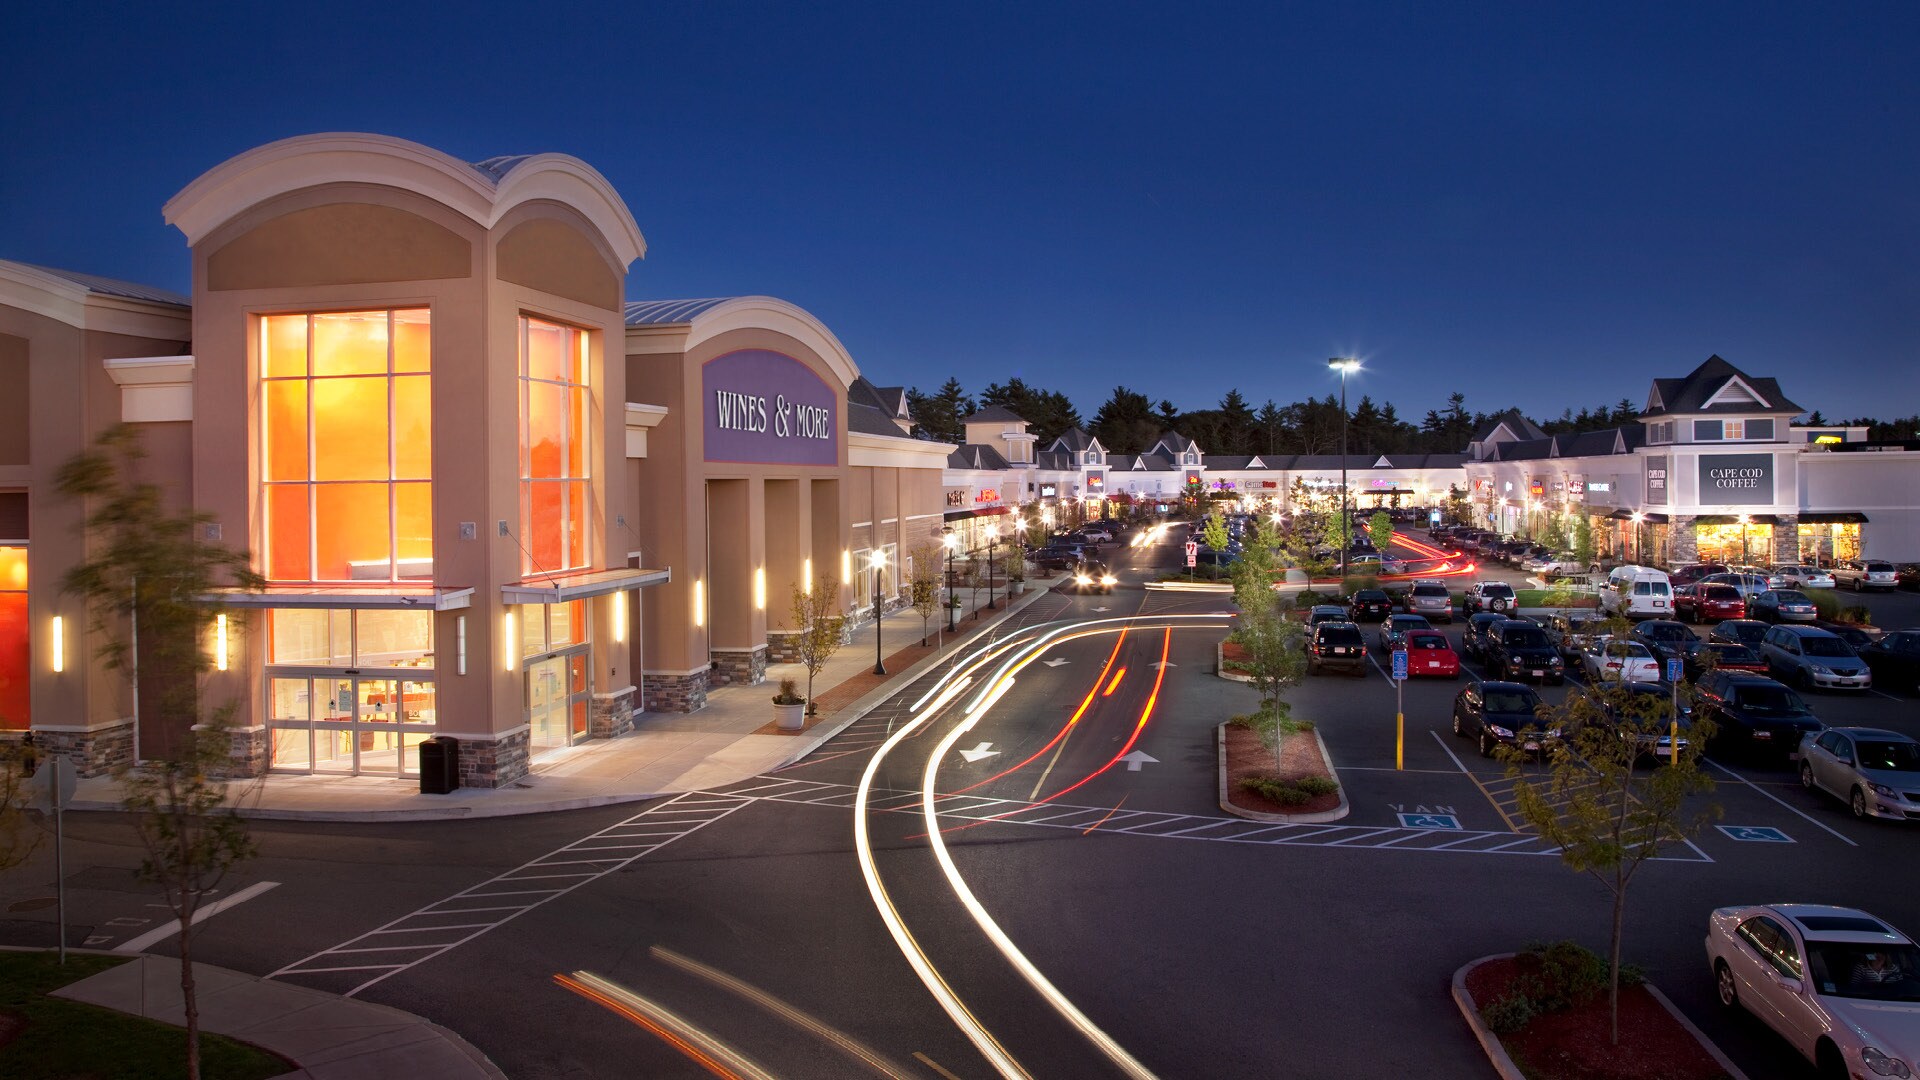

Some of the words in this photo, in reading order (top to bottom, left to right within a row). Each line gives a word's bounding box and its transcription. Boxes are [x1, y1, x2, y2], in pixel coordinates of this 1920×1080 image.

[717, 390, 767, 433] WINES
[775, 394, 791, 438] &
[796, 404, 829, 439] MORE
[1648, 469, 1658, 479] CAPE
[1658, 469, 1666, 479] COD
[1710, 468, 1738, 479] CAPE
[1740, 468, 1763, 479] COD
[1650, 479, 1664, 489] COFFEE
[1716, 478, 1758, 489] COFFEE
[1386, 803, 1457, 815] VAN
